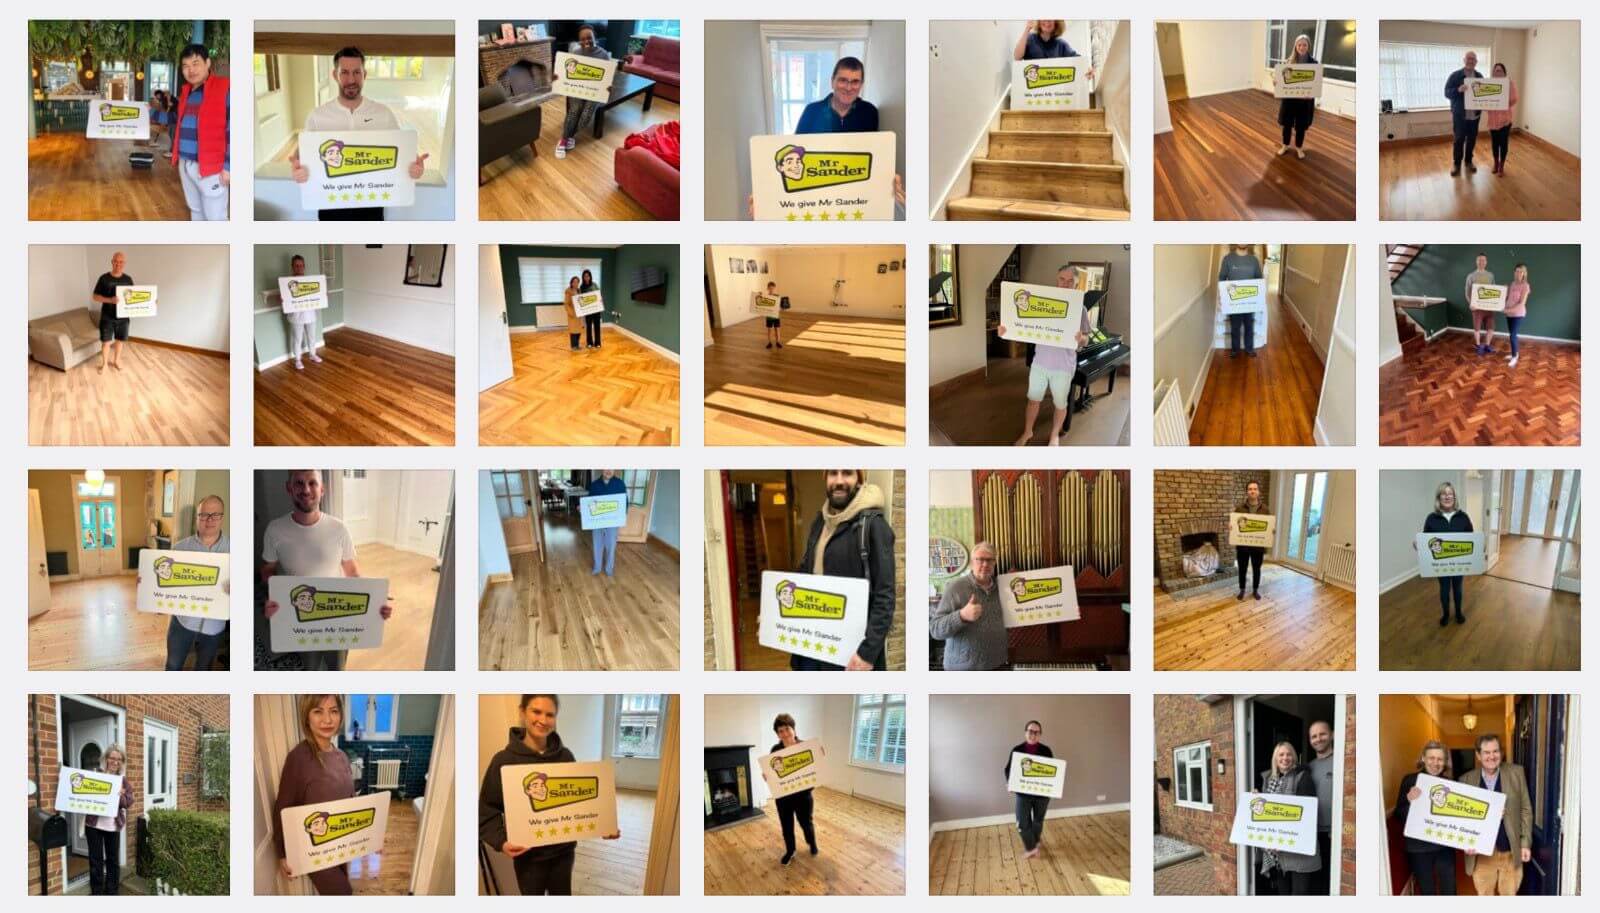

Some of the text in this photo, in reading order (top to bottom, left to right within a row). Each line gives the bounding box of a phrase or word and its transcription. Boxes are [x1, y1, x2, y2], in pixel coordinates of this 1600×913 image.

[345, 155, 392, 166] Sander
[806, 165, 866, 177] Sander
[779, 198, 868, 209] We give Mr Sander
[1030, 304, 1064, 314] Sander
[174, 572, 215, 582] Sander
[1028, 586, 1058, 594] Sander
[316, 602, 365, 611] Sander
[796, 600, 842, 614] Sander
[802, 628, 812, 636] Mr
[814, 630, 842, 642] Sander
[550, 786, 596, 798] Sander
[1264, 810, 1298, 818] Sander
[1446, 802, 1484, 816] Sander
[544, 816, 559, 825] give
[574, 813, 599, 821] Sander
[329, 818, 372, 832] Sander
